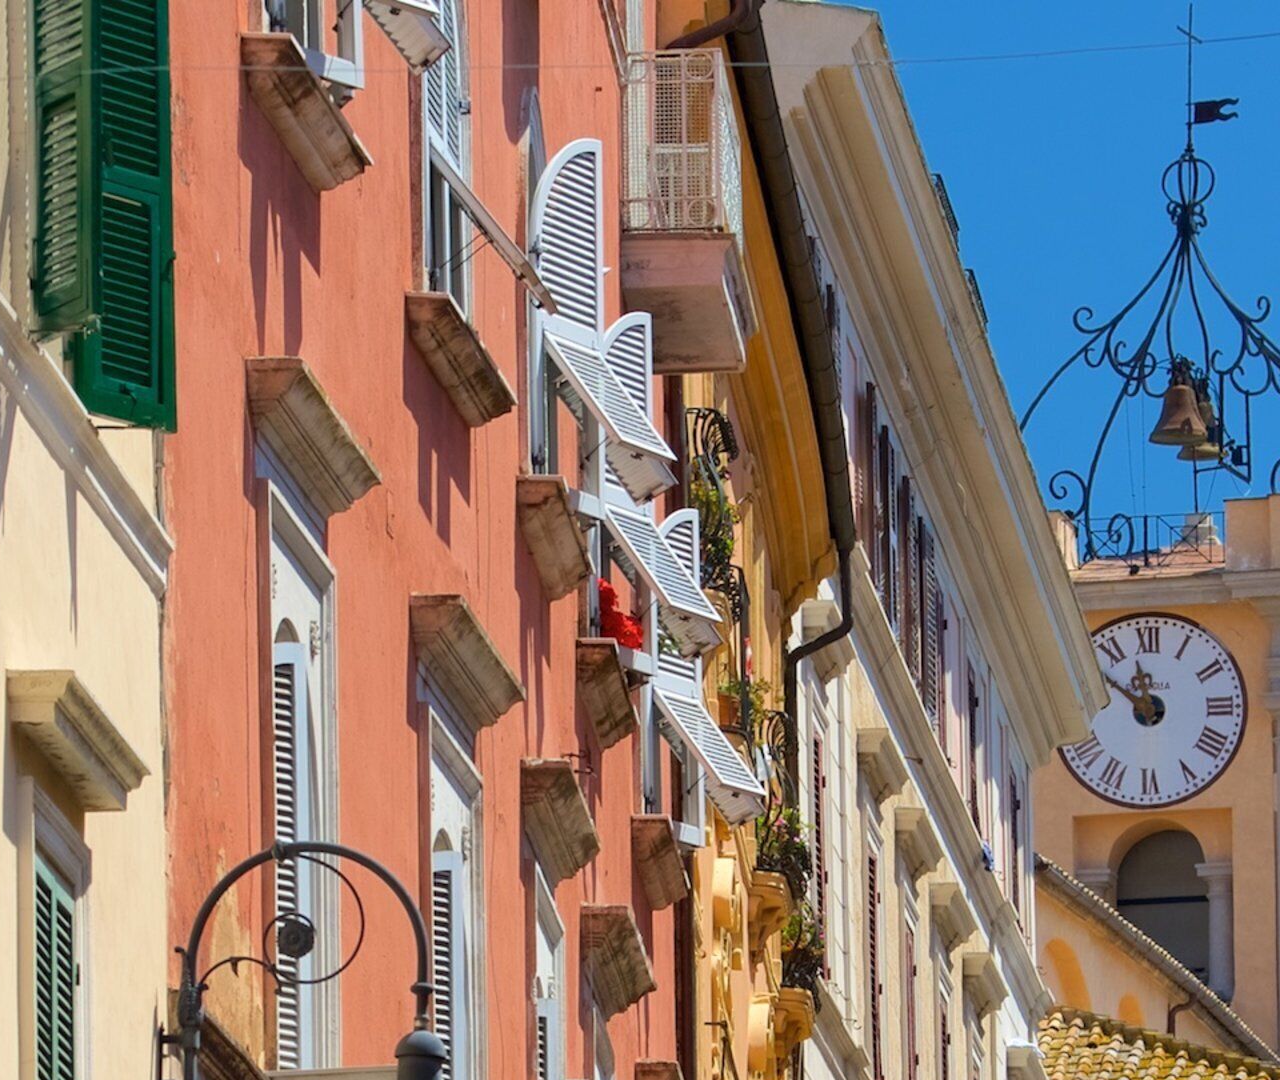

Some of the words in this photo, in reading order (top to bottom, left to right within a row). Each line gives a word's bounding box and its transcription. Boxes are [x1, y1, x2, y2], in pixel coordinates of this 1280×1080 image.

[1098, 636, 1127, 667] XI
[1135, 627, 1160, 655] XII
[1175, 634, 1192, 661] I
[1196, 658, 1224, 684] II
[1206, 696, 1233, 717] III
[1195, 726, 1229, 760] IIII
[1098, 757, 1128, 791] VII
[1140, 768, 1160, 795] VI
[1178, 758, 1198, 785] V
